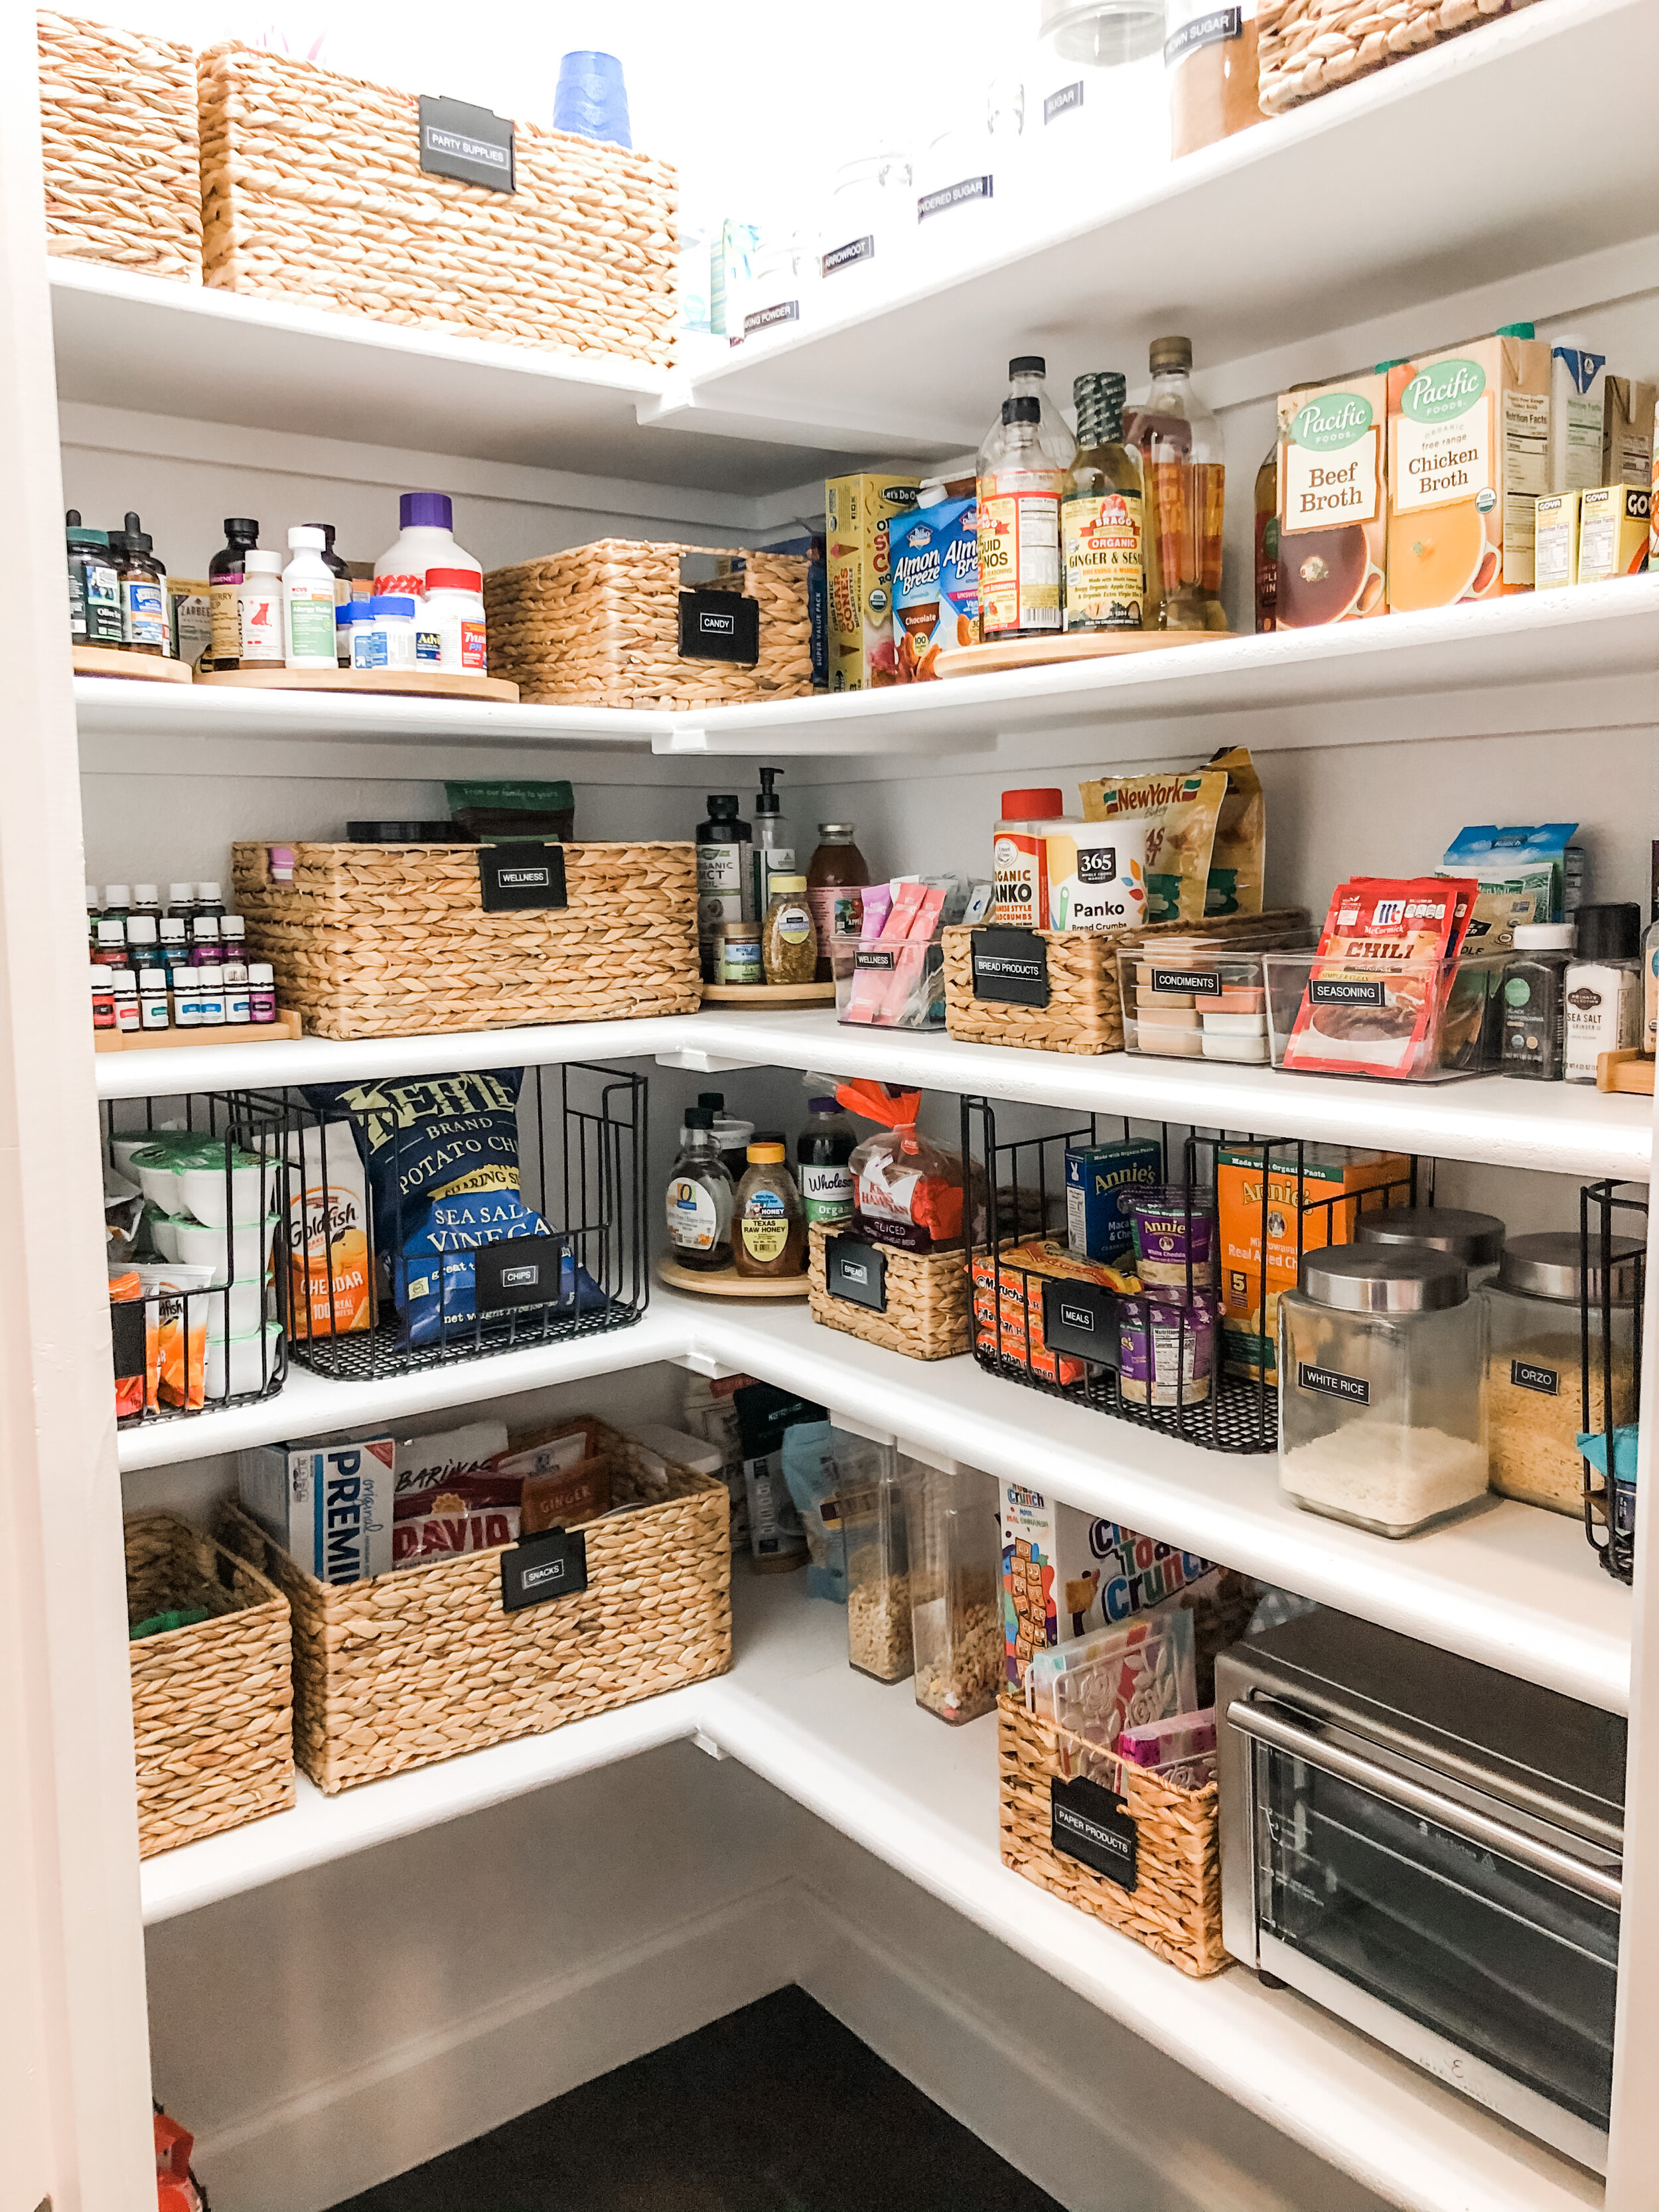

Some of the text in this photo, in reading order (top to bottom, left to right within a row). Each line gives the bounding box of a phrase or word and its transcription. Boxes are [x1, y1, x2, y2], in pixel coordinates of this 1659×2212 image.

[1189, 15, 1229, 39] SUGAR
[1047, 90, 1075, 114] SUGAR
[432, 133, 504, 163] PARTY SUPPLIES
[953, 180, 983, 202] SUGAR
[825, 242, 867, 268] ARROWROOT
[761, 305, 791, 324] POWDER
[1409, 367, 1479, 410] Pacific
[1427, 400, 1463, 416] FOODS
[1299, 402, 1367, 438] Pacific
[1506, 410, 1548, 425] Nutrition Facts
[1316, 431, 1351, 444] FOODS
[1422, 433, 1467, 451] free range
[1408, 448, 1479, 475] Chicken
[1308, 462, 1358, 488] Beef
[1419, 470, 1469, 494] Broth
[881, 488, 899, 499] Let's
[1299, 486, 1363, 513] Broth
[1585, 492, 1608, 502] GOYA
[1539, 500, 1561, 510] GOYA
[1628, 494, 1648, 515] GO
[1095, 516, 1133, 527] BRAGG
[1092, 538, 1135, 548] ORGANIC
[893, 548, 940, 584] Almon
[1069, 552, 1119, 568] GINGER &
[902, 567, 940, 595] Breeze
[833, 574, 847, 633] SUGAR
[840, 567, 855, 634] CONES
[704, 618, 730, 628] CANDY
[905, 613, 937, 626] Chocolate
[914, 636, 926, 645] 100
[1080, 853, 1112, 872] 365
[502, 873, 544, 883] WELLNESS
[1074, 901, 1125, 918] Panko
[1364, 924, 1404, 935] McCormick
[1344, 941, 1415, 959] CHILI
[858, 955, 889, 965] WELLNESS
[978, 961, 1039, 976] BREAD PRODUCTS
[1159, 975, 1214, 989] CONDIMENTS
[1317, 986, 1376, 999] SEASONING
[1567, 1013, 1602, 1024] SEA SALT
[425, 1117, 493, 1140] BRAND
[399, 1136, 482, 1195] POTATO
[1232, 1157, 1252, 1167] Made
[1303, 1168, 1326, 1178] Pasta
[1095, 1161, 1156, 1196] Annie's
[434, 1209, 474, 1226] SEA
[1108, 1220, 1129, 1231] Maca
[874, 1221, 906, 1236] SLICED
[1145, 1220, 1186, 1234] Annie
[1110, 1233, 1116, 1242] &
[1228, 1243, 1252, 1258] Real
[1254, 1249, 1283, 1267] Aed
[507, 1271, 531, 1282] CHIPS
[844, 1264, 863, 1278] BREAD
[1232, 1274, 1245, 1291] 5
[443, 1313, 464, 1324] net
[1066, 1309, 1090, 1325] MEALS
[1307, 1370, 1364, 1396] WHITE RICE
[1521, 1368, 1552, 1385] ORZO
[362, 1479, 385, 1533] original
[1007, 1487, 1045, 1509] Crunch
[393, 1512, 512, 1559] DAVID
[528, 1565, 560, 1582] SNACKS
[1058, 1810, 1129, 1854] PAPER PRODUCTS
